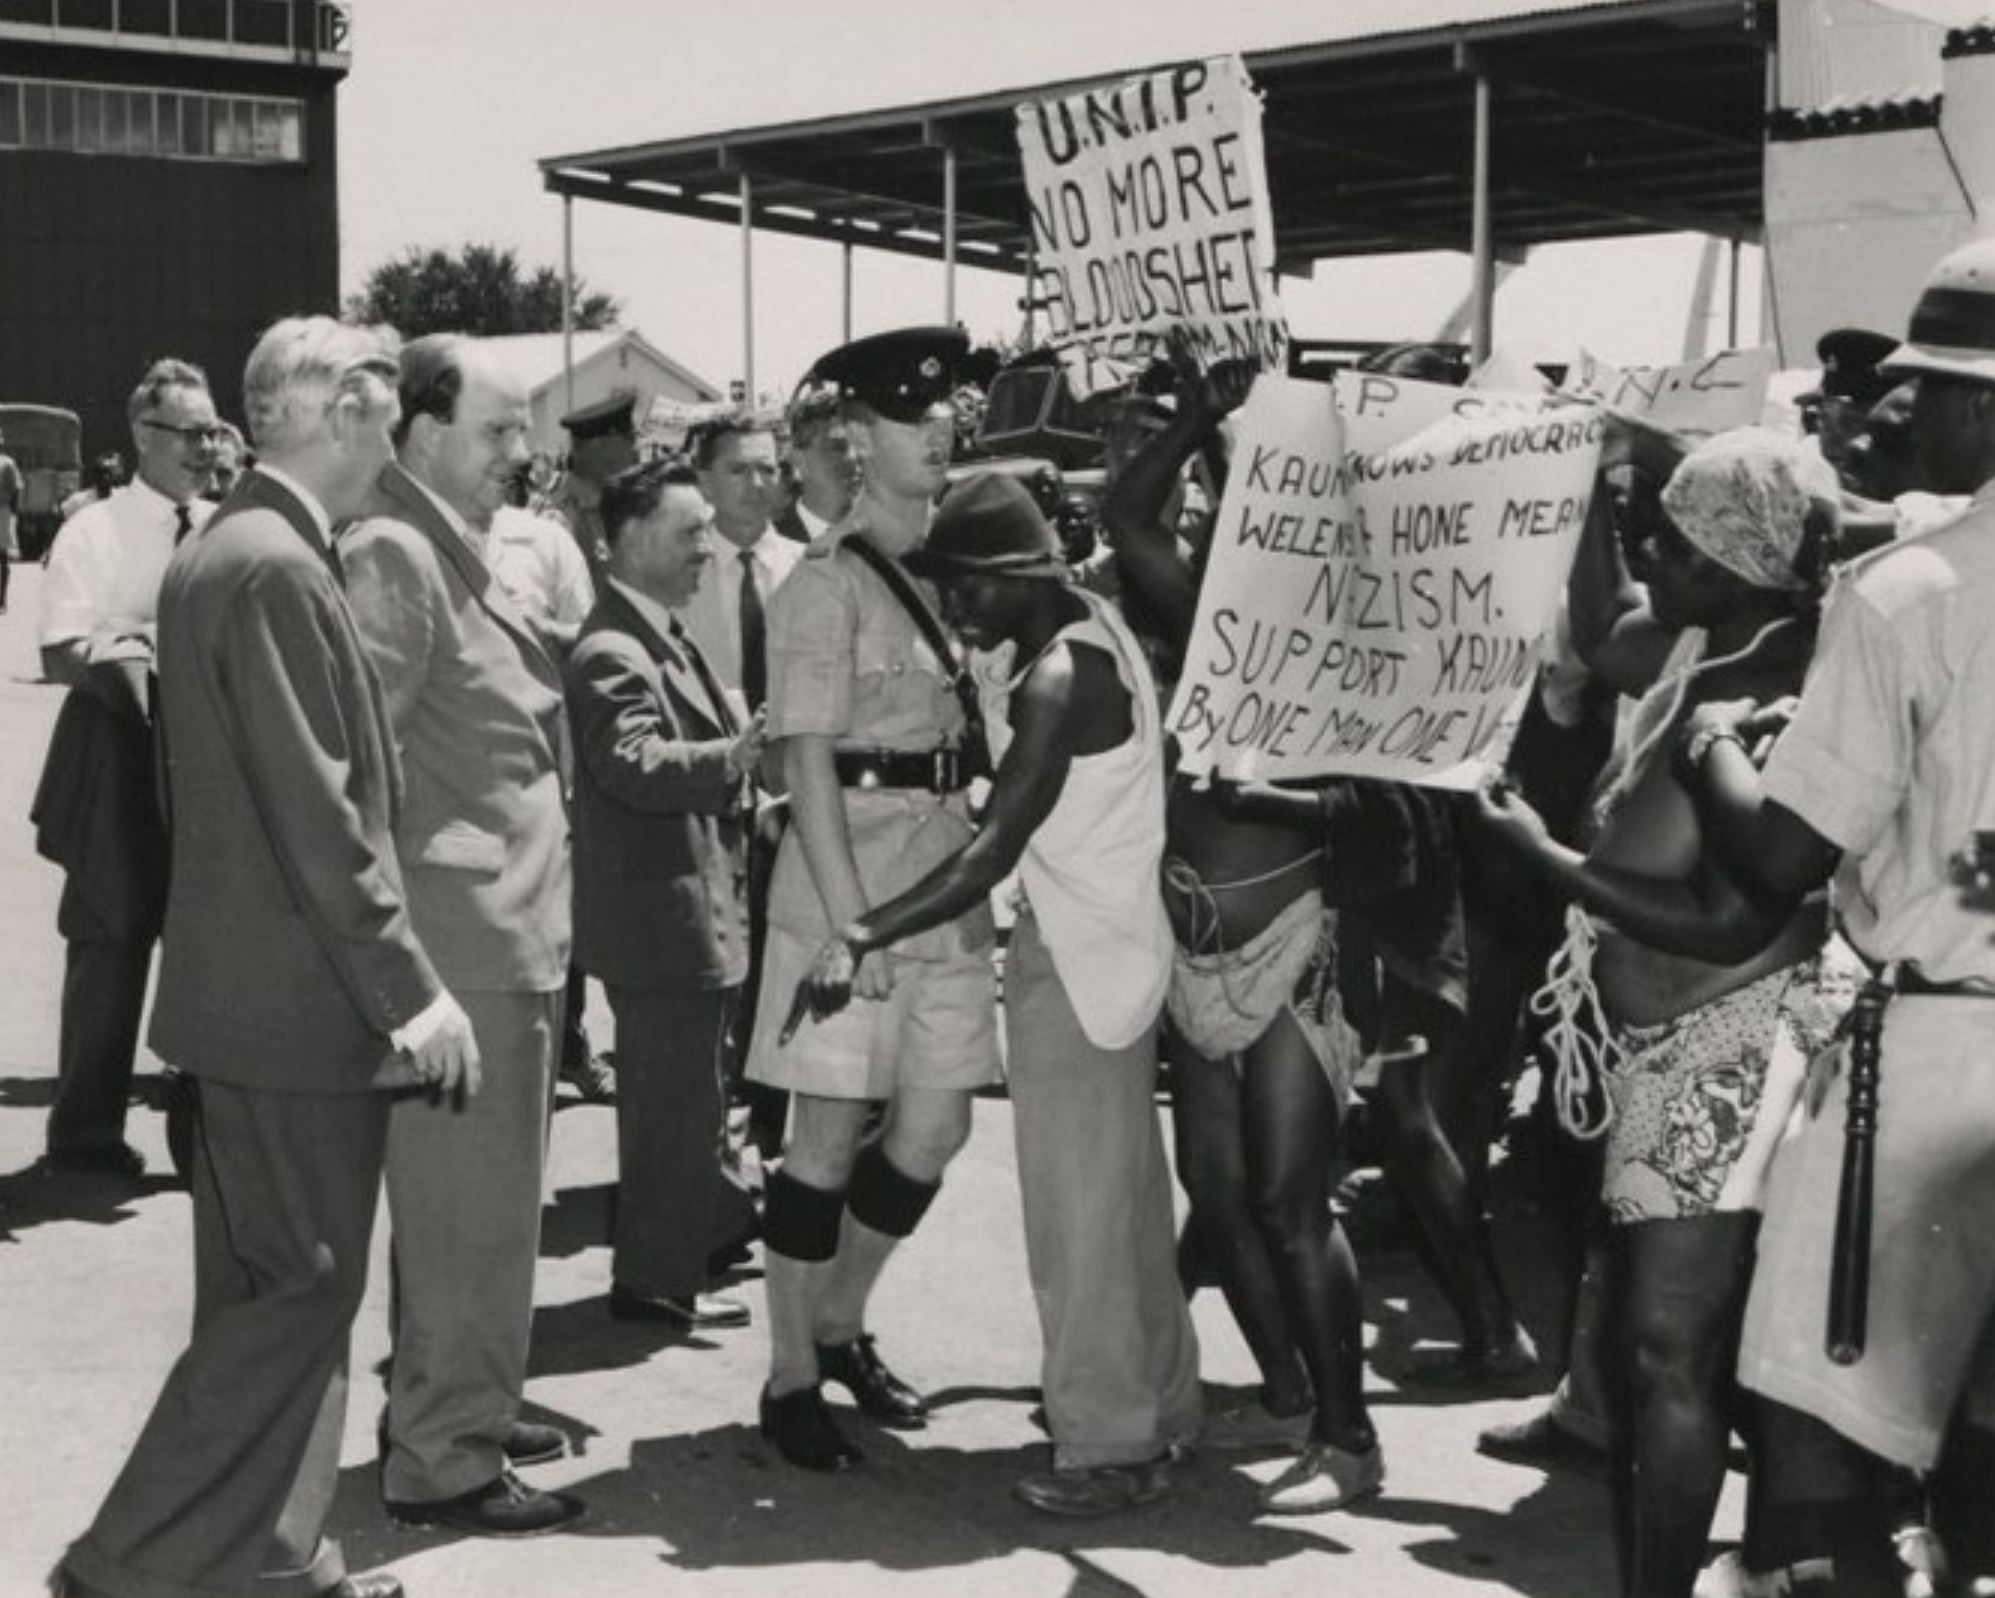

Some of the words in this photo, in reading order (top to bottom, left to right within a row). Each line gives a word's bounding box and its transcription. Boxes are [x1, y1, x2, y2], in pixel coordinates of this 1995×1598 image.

[1037, 61, 1214, 165] U.N.I.P.
[1030, 181, 1090, 252] NO
[1106, 133, 1252, 239] MORE
[1392, 501, 1474, 556] HONE
[1303, 563, 1504, 633] NZISM.
[1209, 608, 1407, 697] SUPPORT
[1431, 632, 1529, 697] KAUN
[1226, 691, 1310, 757] ONE
[1379, 706, 1468, 764] ONE
